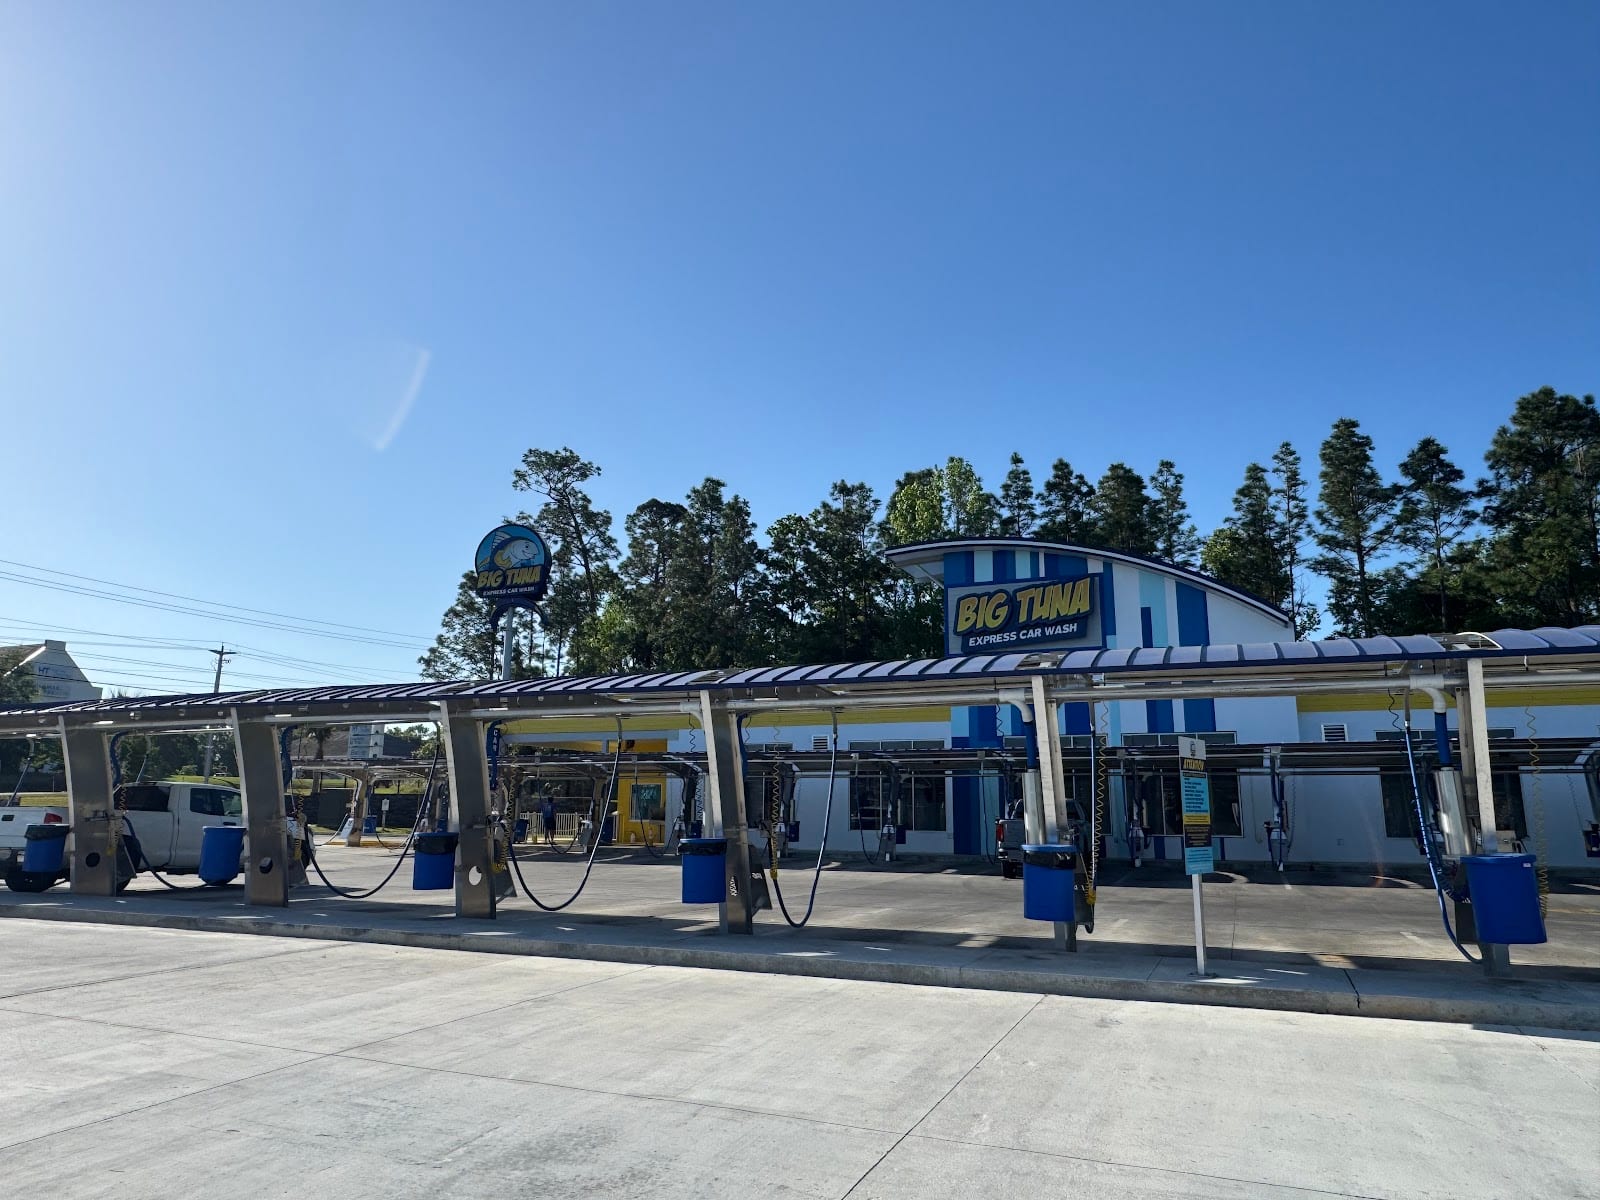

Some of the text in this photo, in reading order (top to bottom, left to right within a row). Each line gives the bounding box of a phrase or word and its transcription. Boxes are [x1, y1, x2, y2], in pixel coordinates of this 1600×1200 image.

[477, 566, 541, 589] BIG TUNA
[957, 577, 1091, 633] BIG TUNA
[968, 623, 1078, 647] EXPRESS CAR WASH
